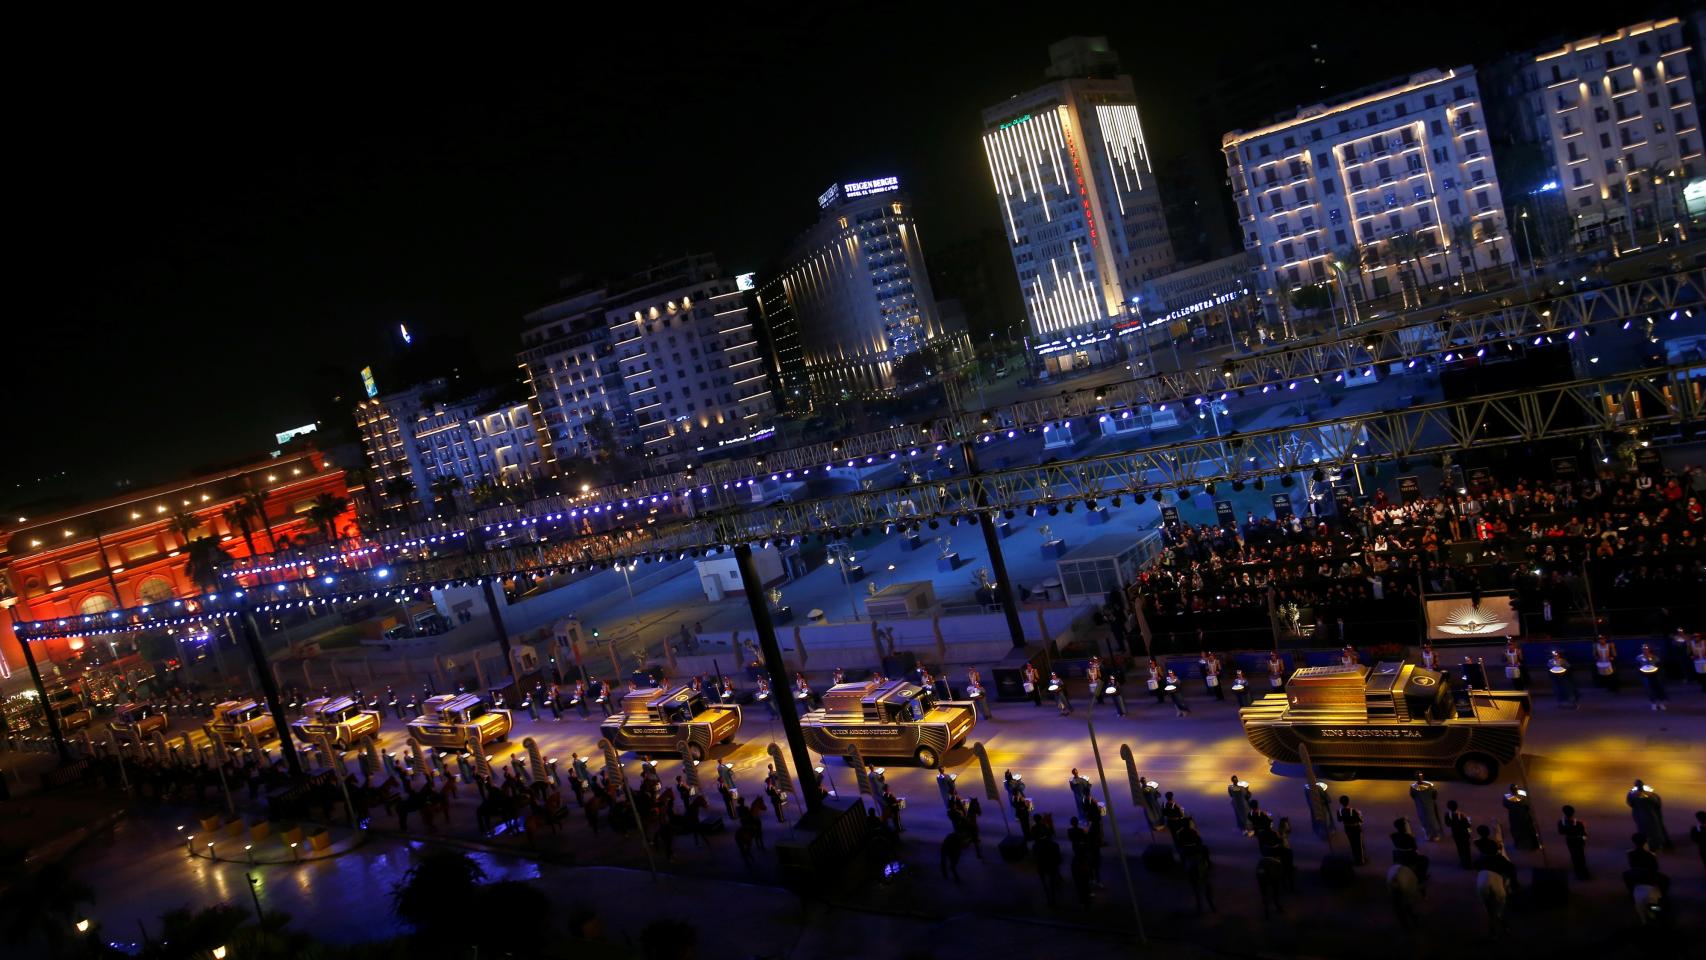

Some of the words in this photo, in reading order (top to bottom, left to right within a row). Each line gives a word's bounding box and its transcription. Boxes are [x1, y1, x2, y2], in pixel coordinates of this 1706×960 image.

[844, 176, 898, 193] STEIGENBERGER
[1171, 299, 1214, 320] CLEOPATRA
[1321, 729, 1344, 737] KING
[1401, 729, 1422, 738] TAA
